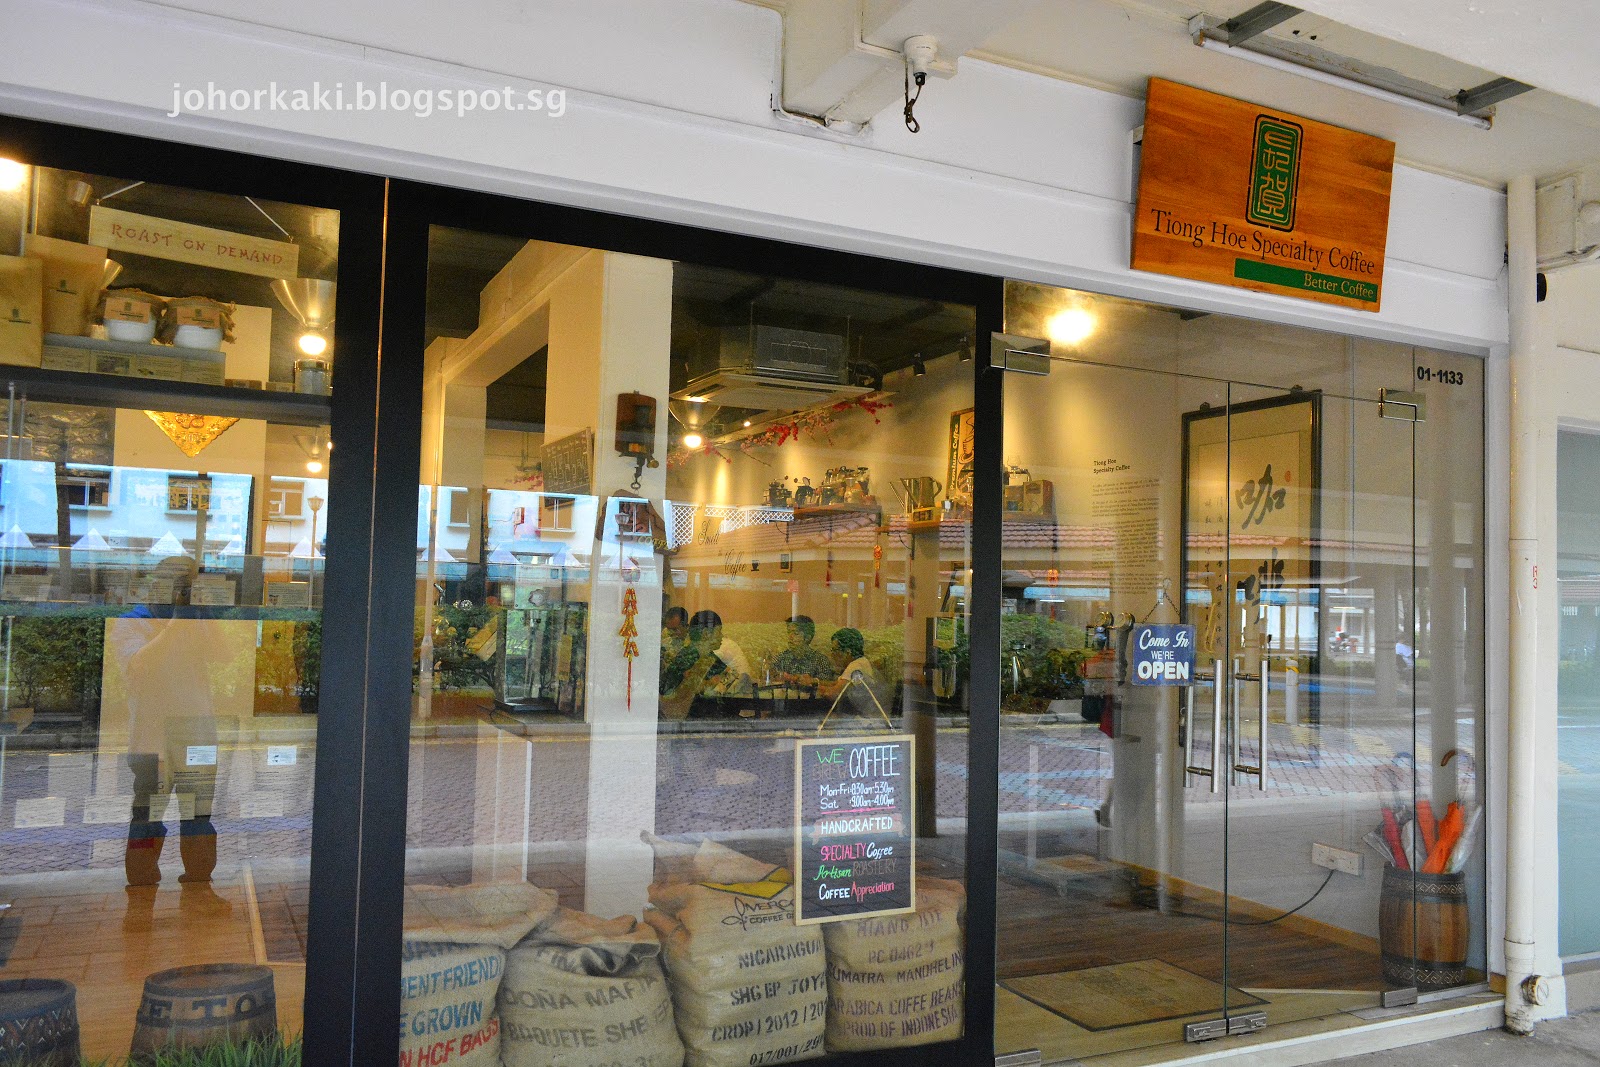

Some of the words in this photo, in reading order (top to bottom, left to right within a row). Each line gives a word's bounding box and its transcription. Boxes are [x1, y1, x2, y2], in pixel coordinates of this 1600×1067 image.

[112, 223, 173, 247] ROAST
[183, 239, 206, 251] ON
[216, 243, 284, 265] DEMAND
[1151, 207, 1206, 248] Tiong
[1210, 221, 1248, 250] Hoe
[1251, 230, 1324, 271] Specialty
[1328, 246, 1376, 275] Coffee
[1303, 273, 1339, 293] Better
[1340, 279, 1374, 299] Coffee
[1416, 365, 1464, 386] 01-1133
[1093, 467, 1115, 475] Specialty
[1139, 629, 1171, 651] Come
[1172, 630, 1190, 648] In
[1150, 650, 1175, 660] WE'RE
[1137, 660, 1190, 680] OPEN
[816, 748, 845, 764] WE
[849, 744, 901, 779] COFFEE
[820, 797, 839, 810] Sat
[821, 816, 893, 835] HANDCRAFTED
[820, 842, 867, 862] SPECIALTY
[866, 842, 894, 860] Coffee
[814, 864, 852, 881] Artisan
[850, 880, 895, 902] Appreciation
[749, 914, 784, 925] COFFEE
[737, 939, 822, 970] NICARAGUA
[827, 961, 886, 984] SUMATRA
[411, 1001, 483, 1036] GROWN
[417, 1037, 457, 1067] HCF
